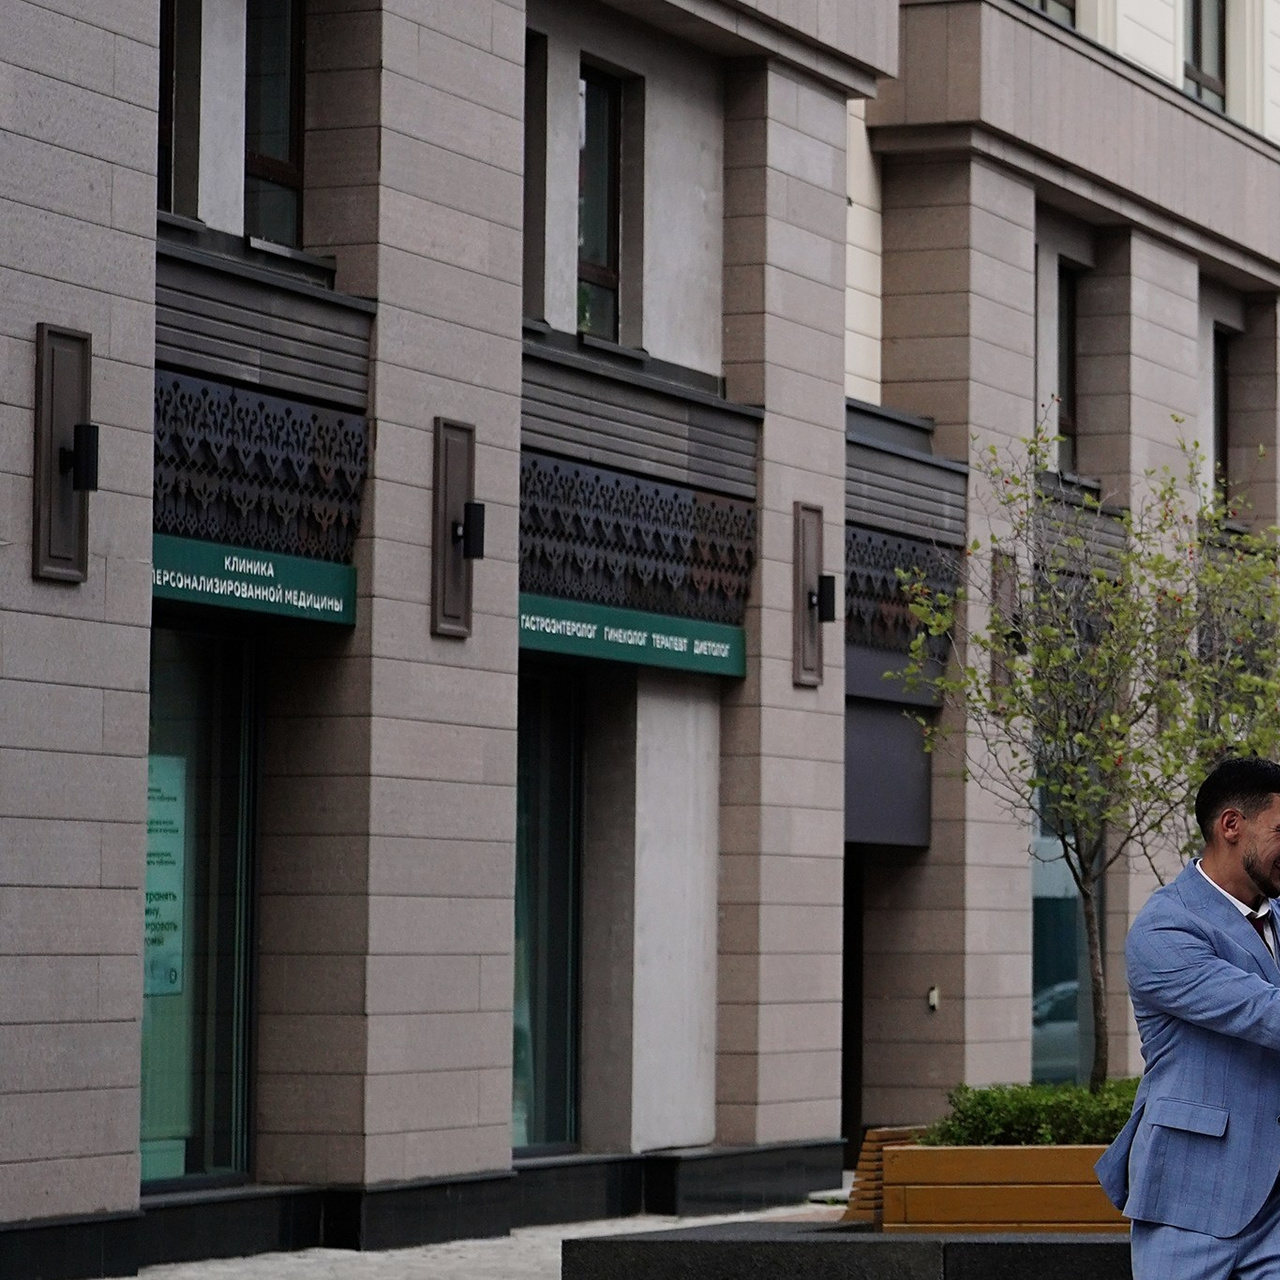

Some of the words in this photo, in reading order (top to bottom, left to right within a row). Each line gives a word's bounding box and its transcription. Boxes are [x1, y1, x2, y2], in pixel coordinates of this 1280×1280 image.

[224, 555, 274, 578] КЛИНИКА
[284, 589, 344, 612] МЕДИЦИНЫ
[520, 614, 598, 639] ГАСТРОЭНТЕРОЛОГ
[604, 626, 648, 646] ГИНЕКОЛОГ
[651, 633, 688, 652] ТЕРАПЕВТ
[693, 639, 731, 658] ДИЕТОЛОГ
